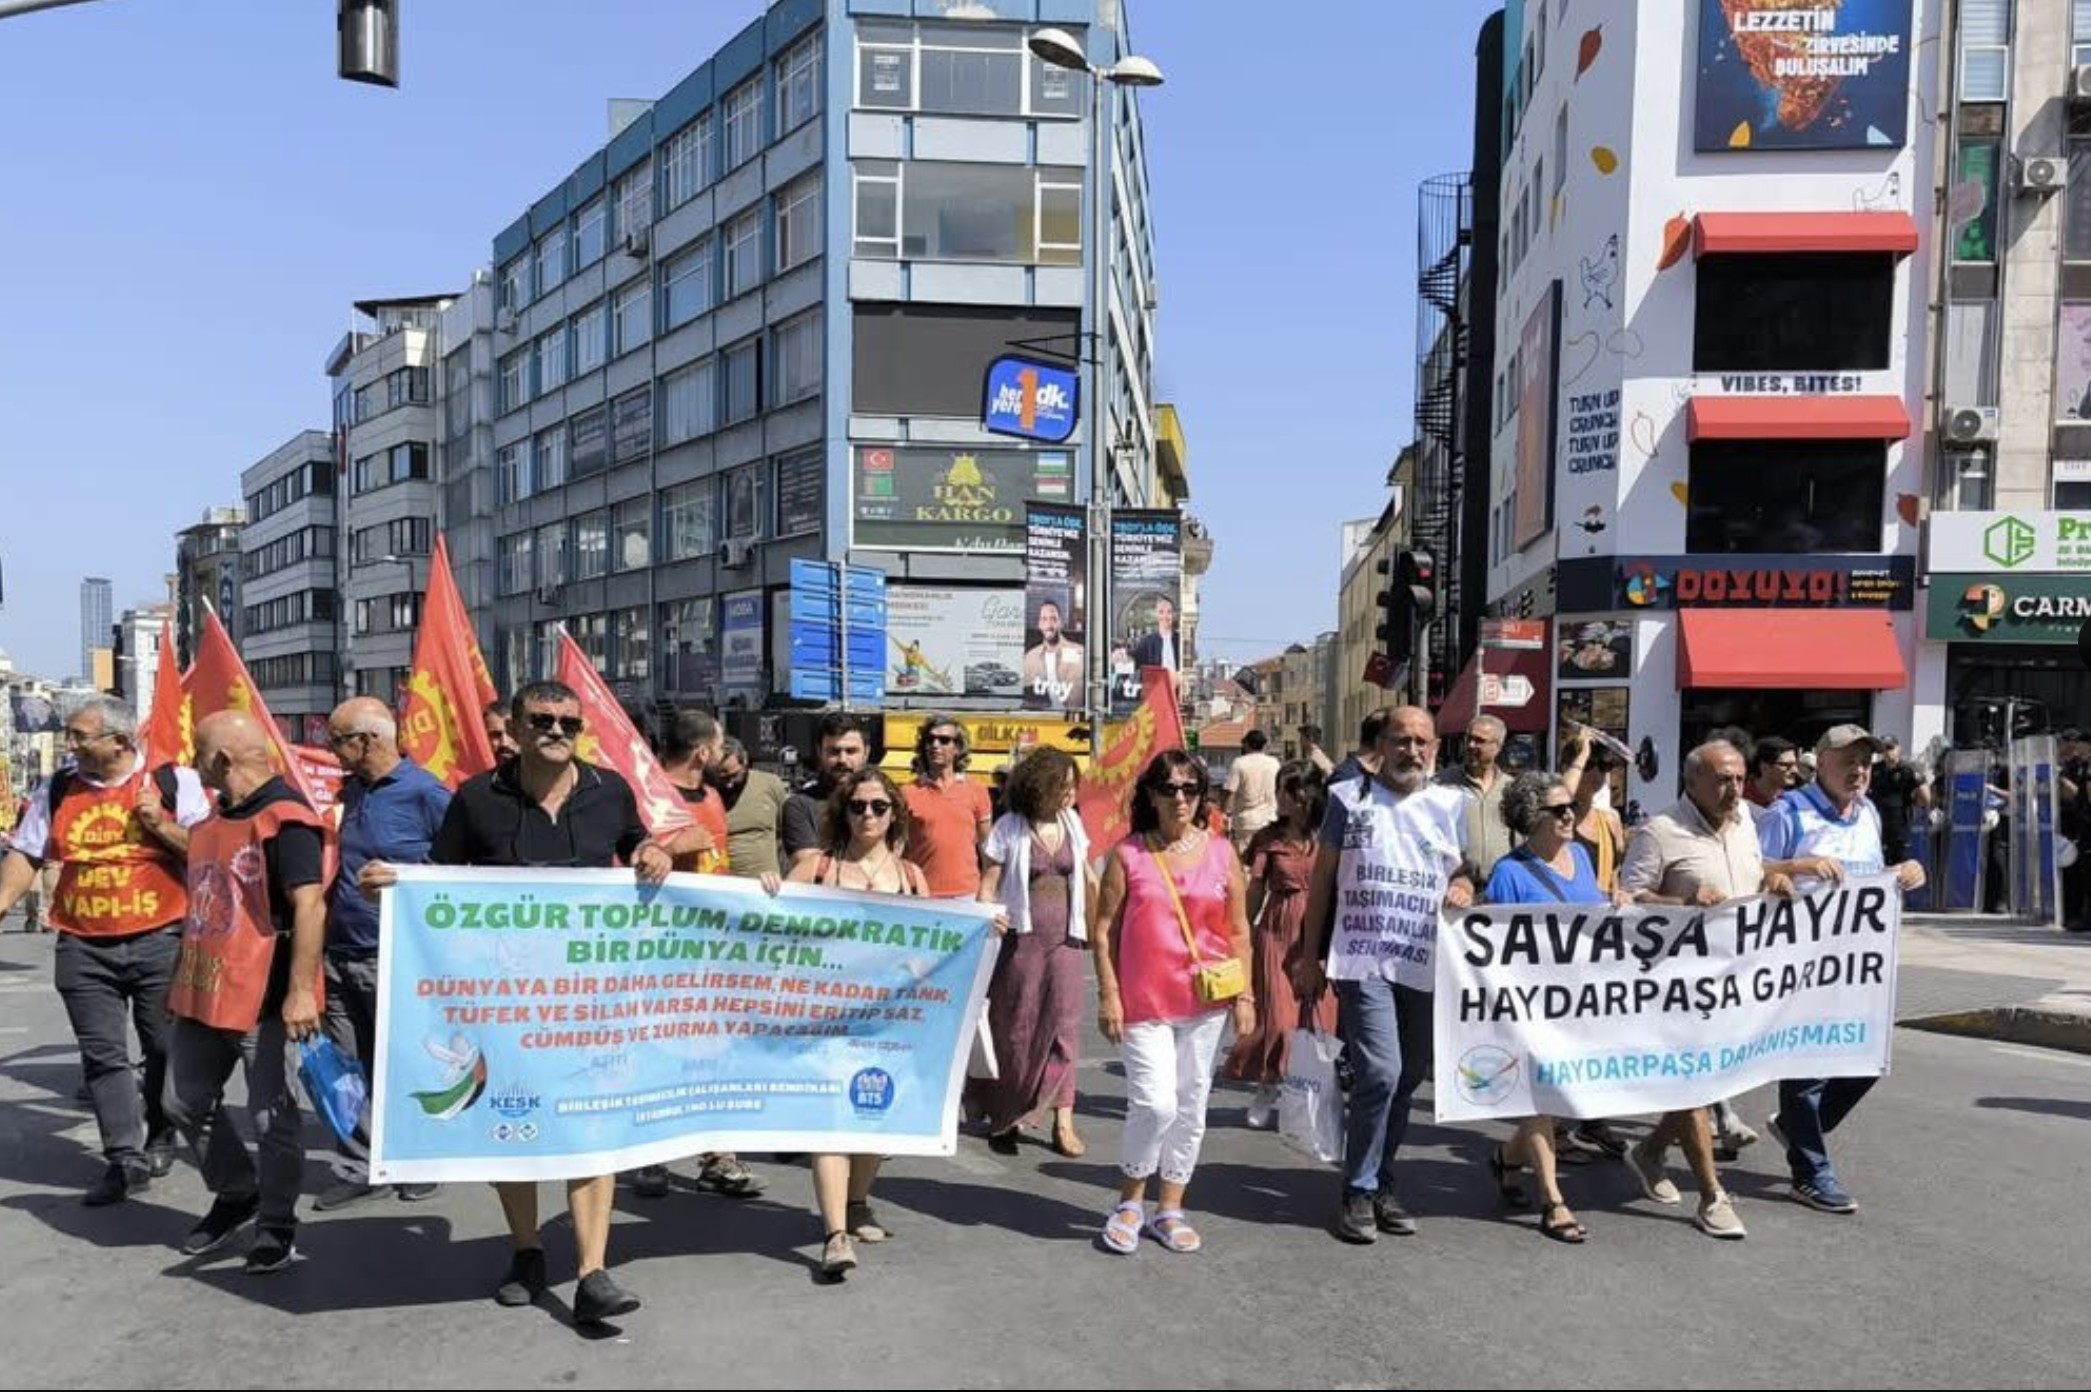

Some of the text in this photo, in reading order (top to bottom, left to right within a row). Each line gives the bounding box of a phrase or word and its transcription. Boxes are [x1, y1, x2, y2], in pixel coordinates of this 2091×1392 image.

[1734, 6, 1836, 32] LEZZETİN
[1775, 56, 1868, 82] BULUŞALIM
[1721, 376, 1862, 393] VIBES, BITES!
[1017, 367, 1038, 431] 1
[932, 485, 996, 499] HAN
[915, 506, 1012, 521] KARGO
[2057, 517, 2091, 540] Pr
[1676, 569, 1849, 600] DOYUYO!
[1033, 676, 1073, 702] troy
[1123, 680, 1142, 697] tr
[78, 866, 132, 889] DEV
[424, 894, 966, 953] ÖZGÜR TOPLUM, DEMOKRATİK
[1463, 885, 1886, 971] SAVAŞA HAYIR
[566, 930, 844, 972] BİR DÜNYA İÇİN...
[416, 974, 548, 997] DÜNYAYA
[553, 970, 599, 996] BİR
[603, 974, 658, 993] DAHA
[660, 968, 777, 995] GELİRSEM,
[779, 976, 809, 995] NE
[814, 979, 891, 1001] KADAR
[1459, 951, 1885, 1023] HAYDARPAŞA GARDIR
[443, 1001, 530, 1024] TÜFEK
[536, 1004, 569, 1023] VE
[573, 998, 640, 1022] SİLAH
[641, 995, 709, 1017] VARSA
[712, 993, 805, 1015] HEPSİNİ
[809, 1000, 881, 1021] ERİTİP
[520, 1026, 623, 1050] CÜMBÜŞ
[627, 1025, 648, 1043] VE
[652, 1021, 718, 1040] ZURNA
[1536, 1021, 1866, 1086] HAYDARPAŞA DAYANIŞMASI
[490, 1096, 541, 1109] KESK
